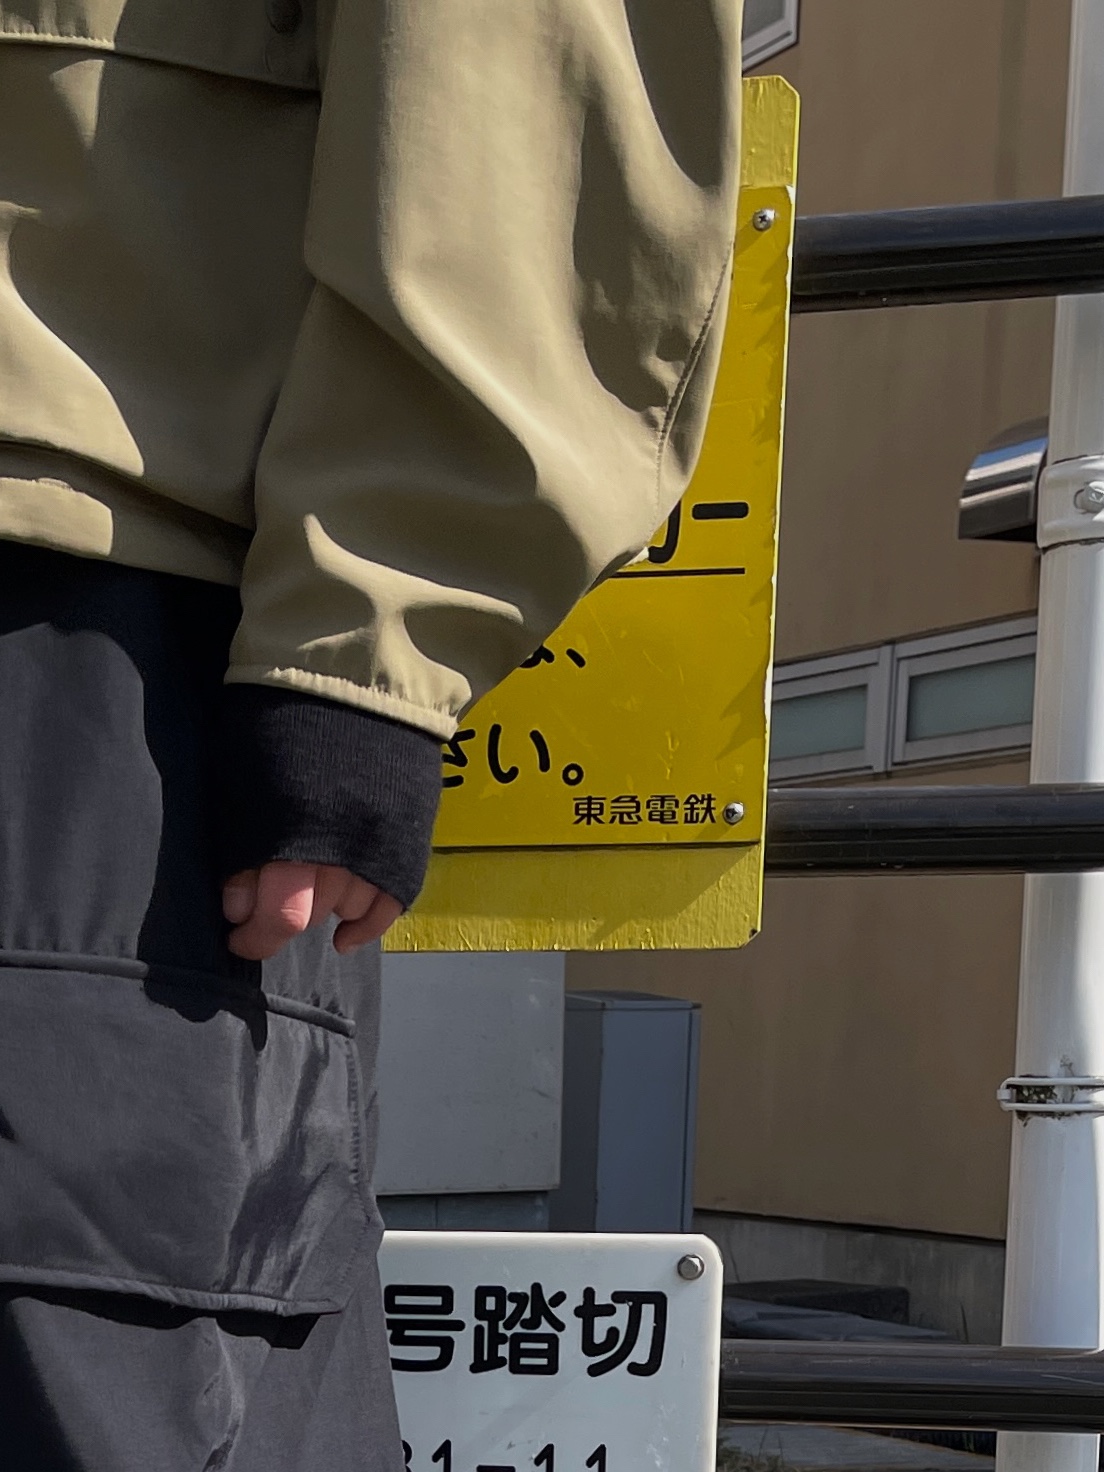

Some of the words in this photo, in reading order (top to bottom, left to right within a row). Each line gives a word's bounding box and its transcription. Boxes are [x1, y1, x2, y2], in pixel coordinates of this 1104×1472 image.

[572, 793, 718, 826] 東急電鉄
[384, 1282, 668, 1377] 号踏切
